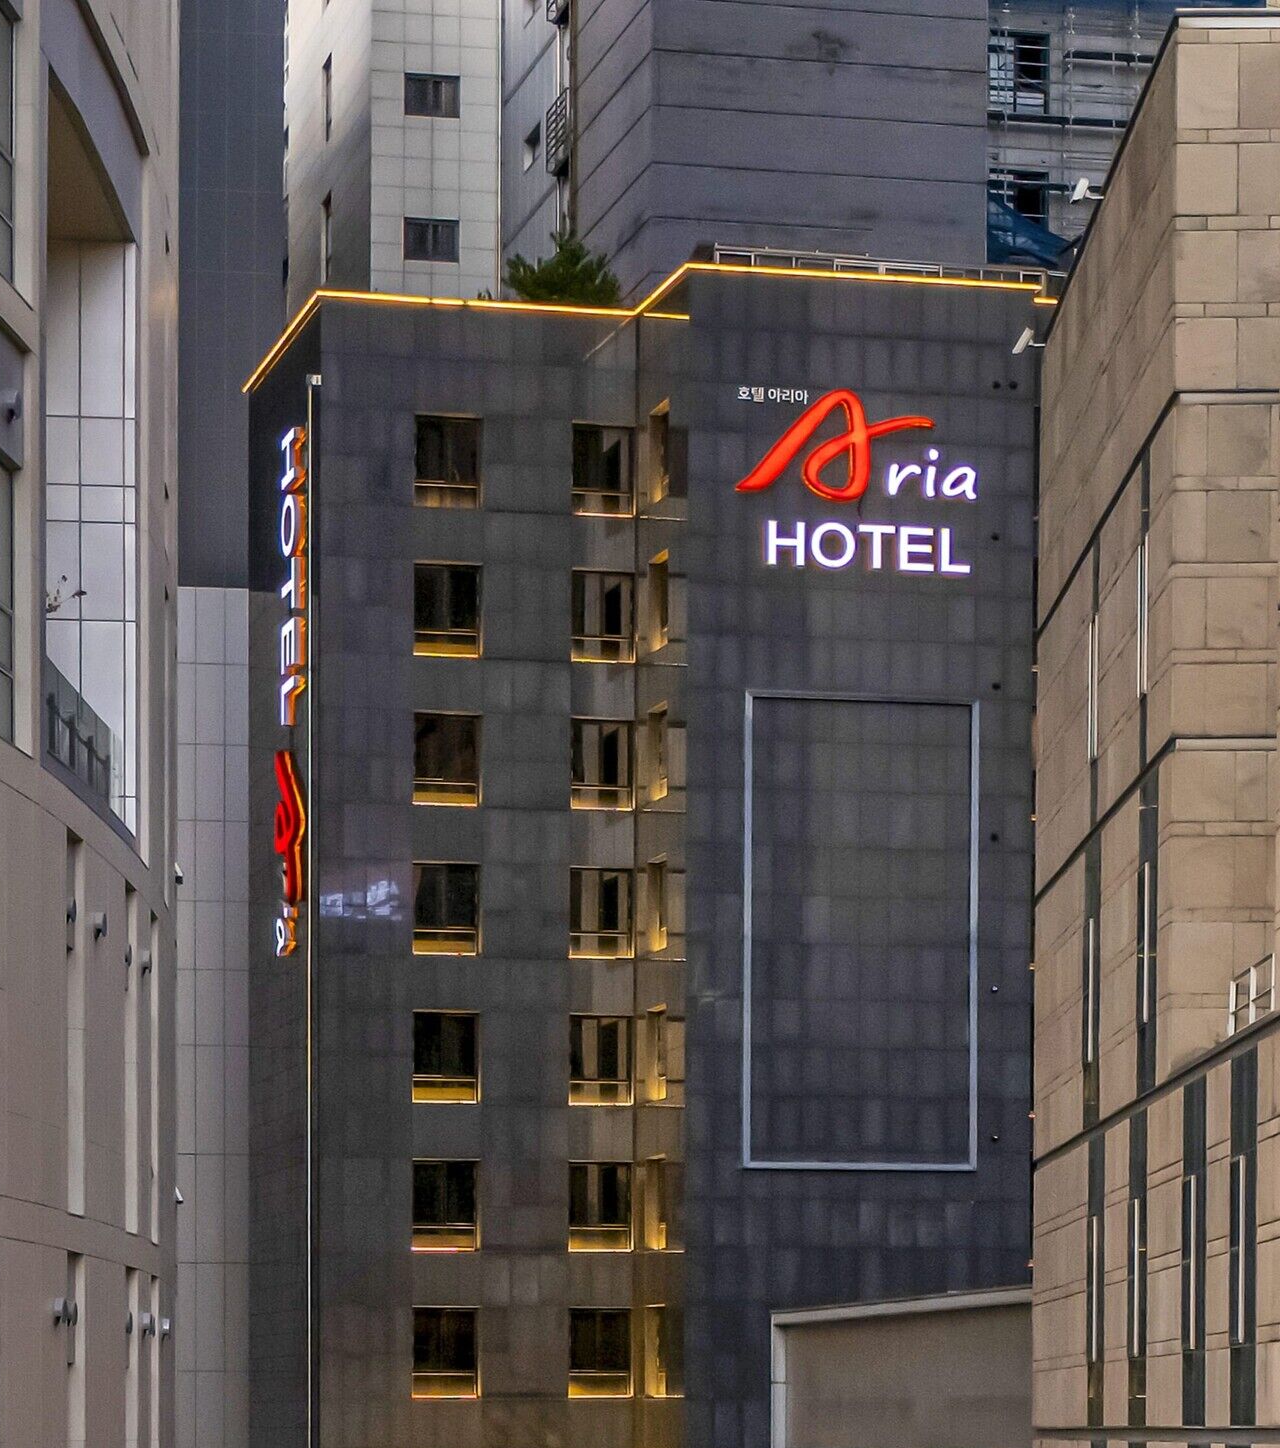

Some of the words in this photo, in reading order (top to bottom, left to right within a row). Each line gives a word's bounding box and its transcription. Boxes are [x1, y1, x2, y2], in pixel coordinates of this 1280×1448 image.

[737, 386, 765, 403] 호텔
[767, 387, 809, 405] 아리아
[735, 389, 977, 501] Aria
[280, 427, 305, 726] HOTEL
[766, 519, 971, 574] HOTEL
